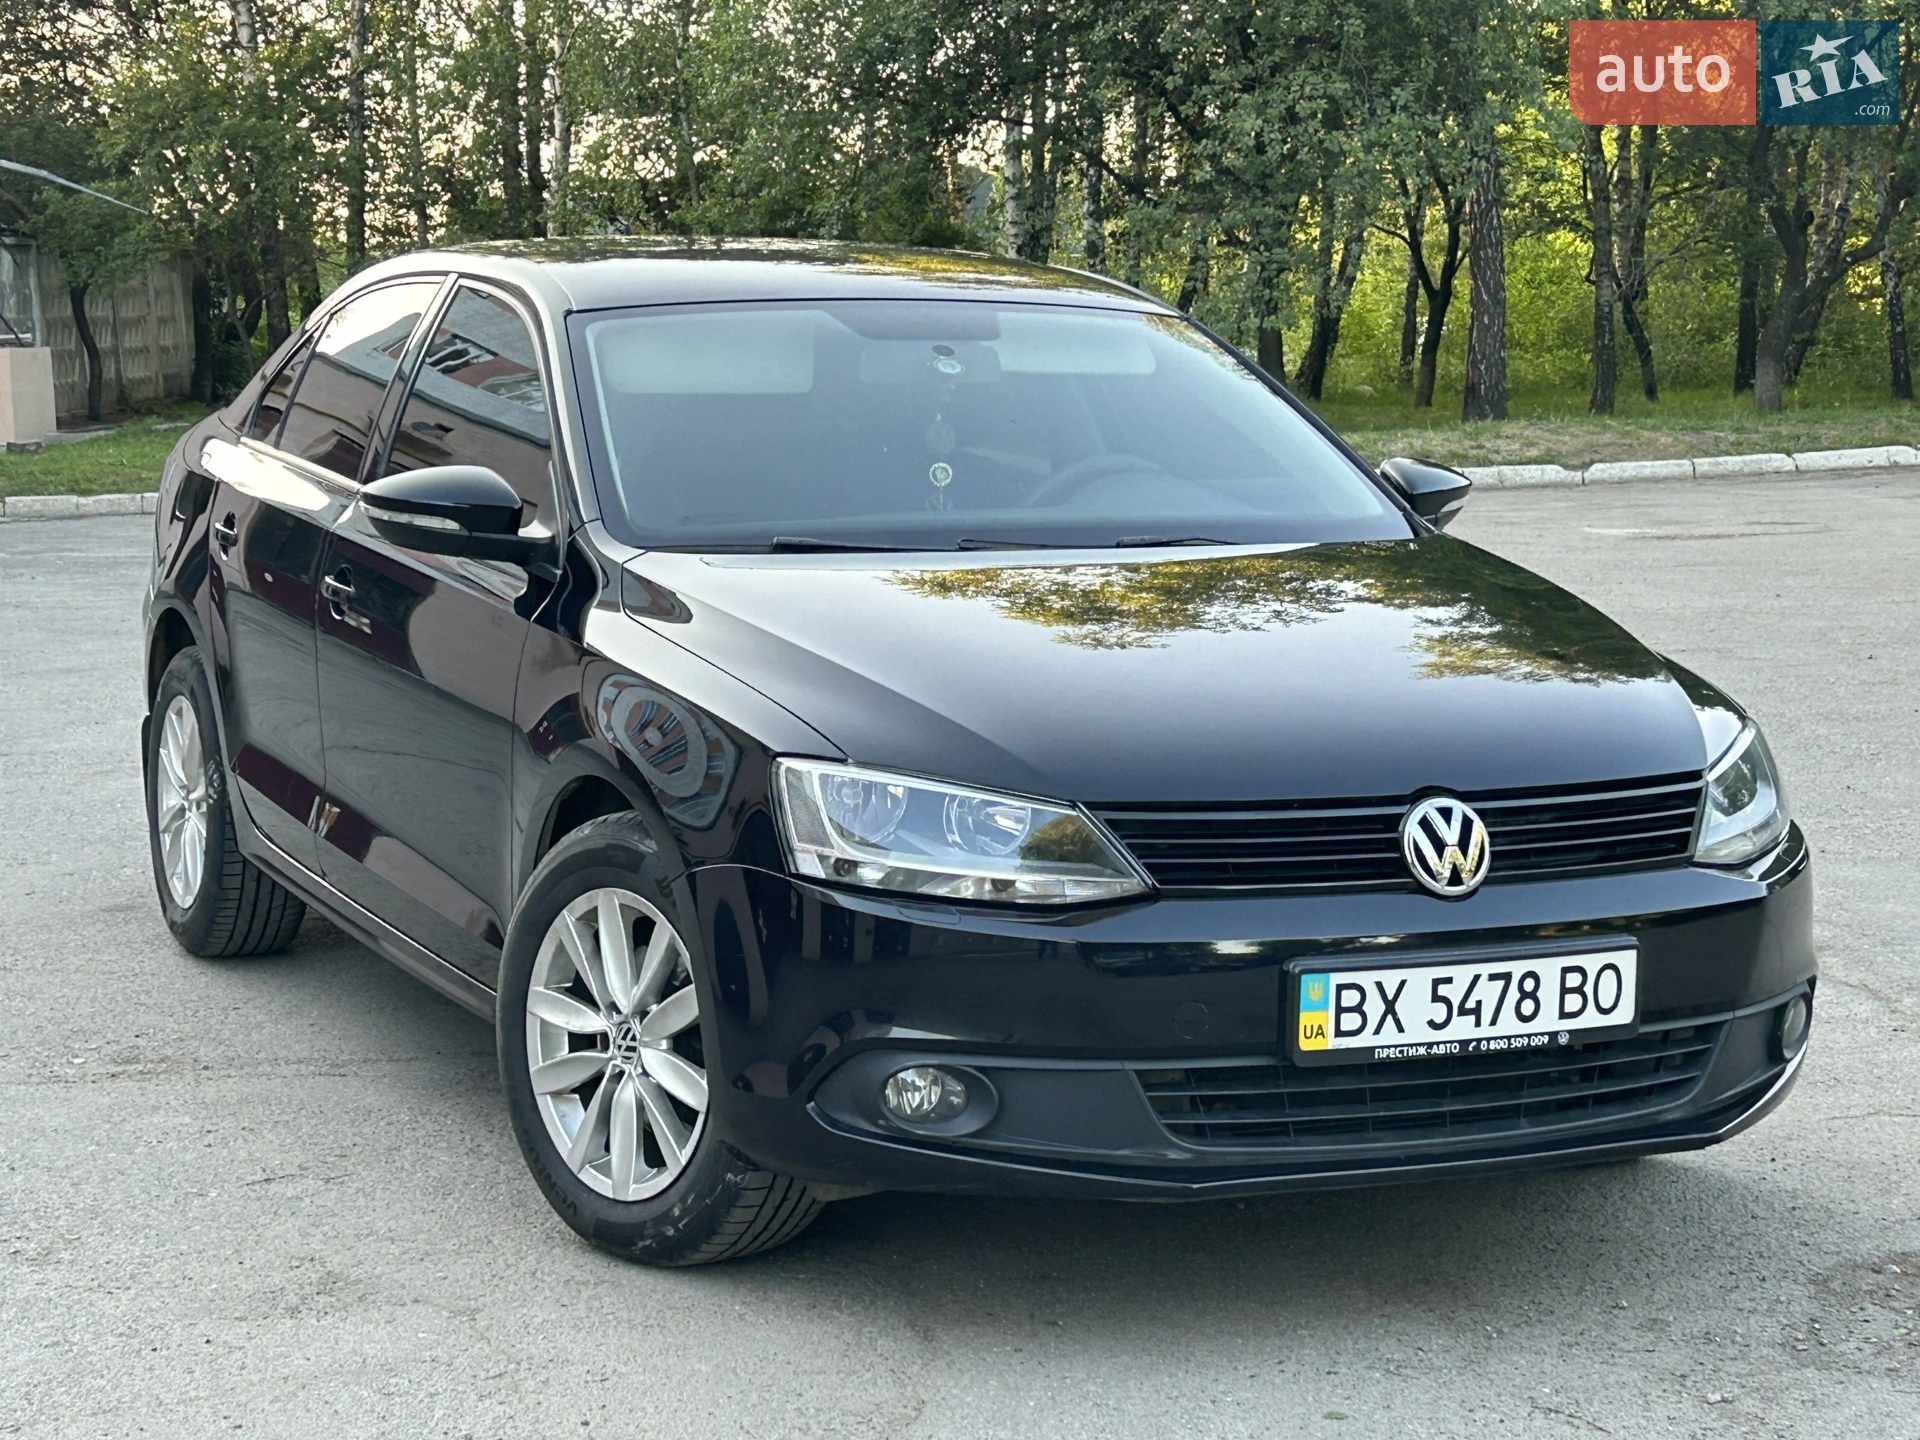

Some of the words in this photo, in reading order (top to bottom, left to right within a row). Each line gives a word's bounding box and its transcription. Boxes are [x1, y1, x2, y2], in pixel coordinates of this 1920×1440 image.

[1333, 978, 1408, 1038] BX
[1426, 970, 1541, 1031] 5478
[1558, 963, 1623, 1020] BO
[1303, 1023, 1326, 1040] UA
[1375, 1042, 1460, 1059] ПРЕСТИЖ-АВТО
[1480, 1039, 1488, 1051] 0
